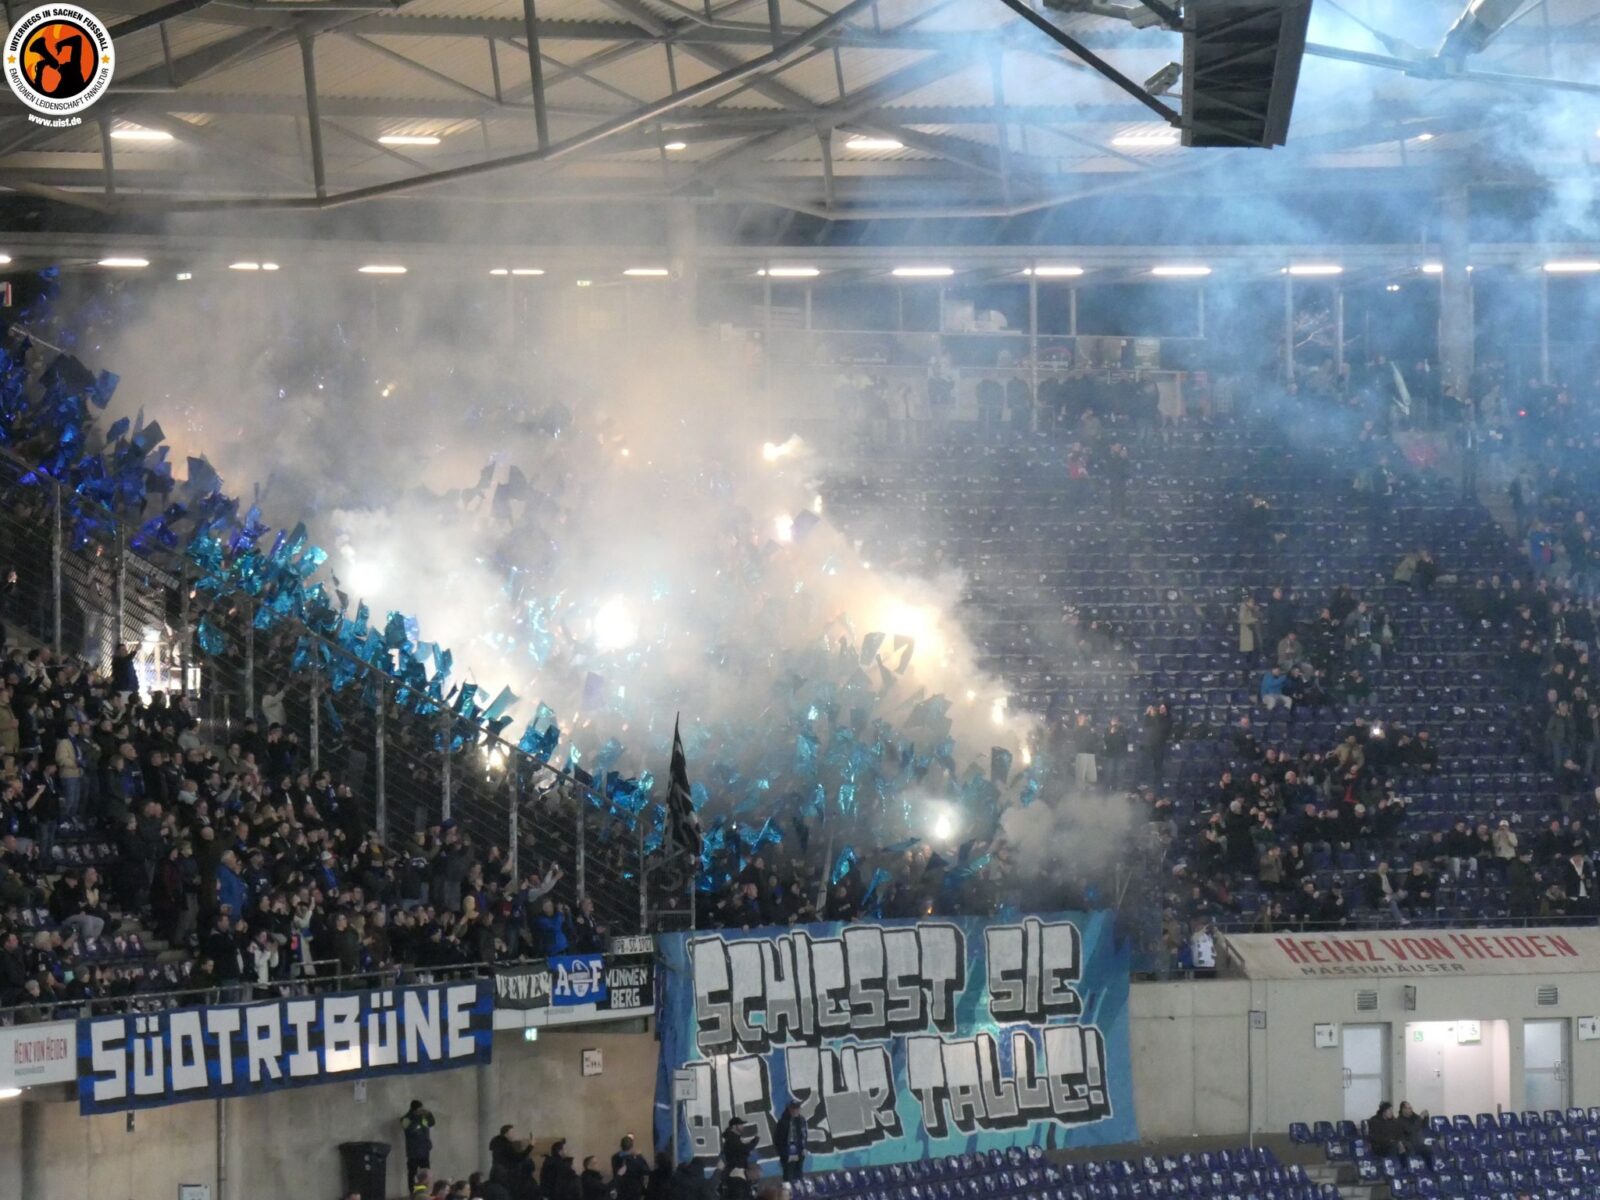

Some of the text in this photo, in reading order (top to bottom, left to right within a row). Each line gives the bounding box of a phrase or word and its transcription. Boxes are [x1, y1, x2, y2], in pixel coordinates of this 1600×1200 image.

[611, 987, 640, 1009] BERG
[689, 916, 1081, 1052] SCHIESST SIE
[1275, 934, 1580, 964] HEINZ VON HEIDEN
[90, 984, 477, 1101] SÜDTRIBÜNE
[683, 1024, 1114, 1160] BIS ZUR TALLE!
